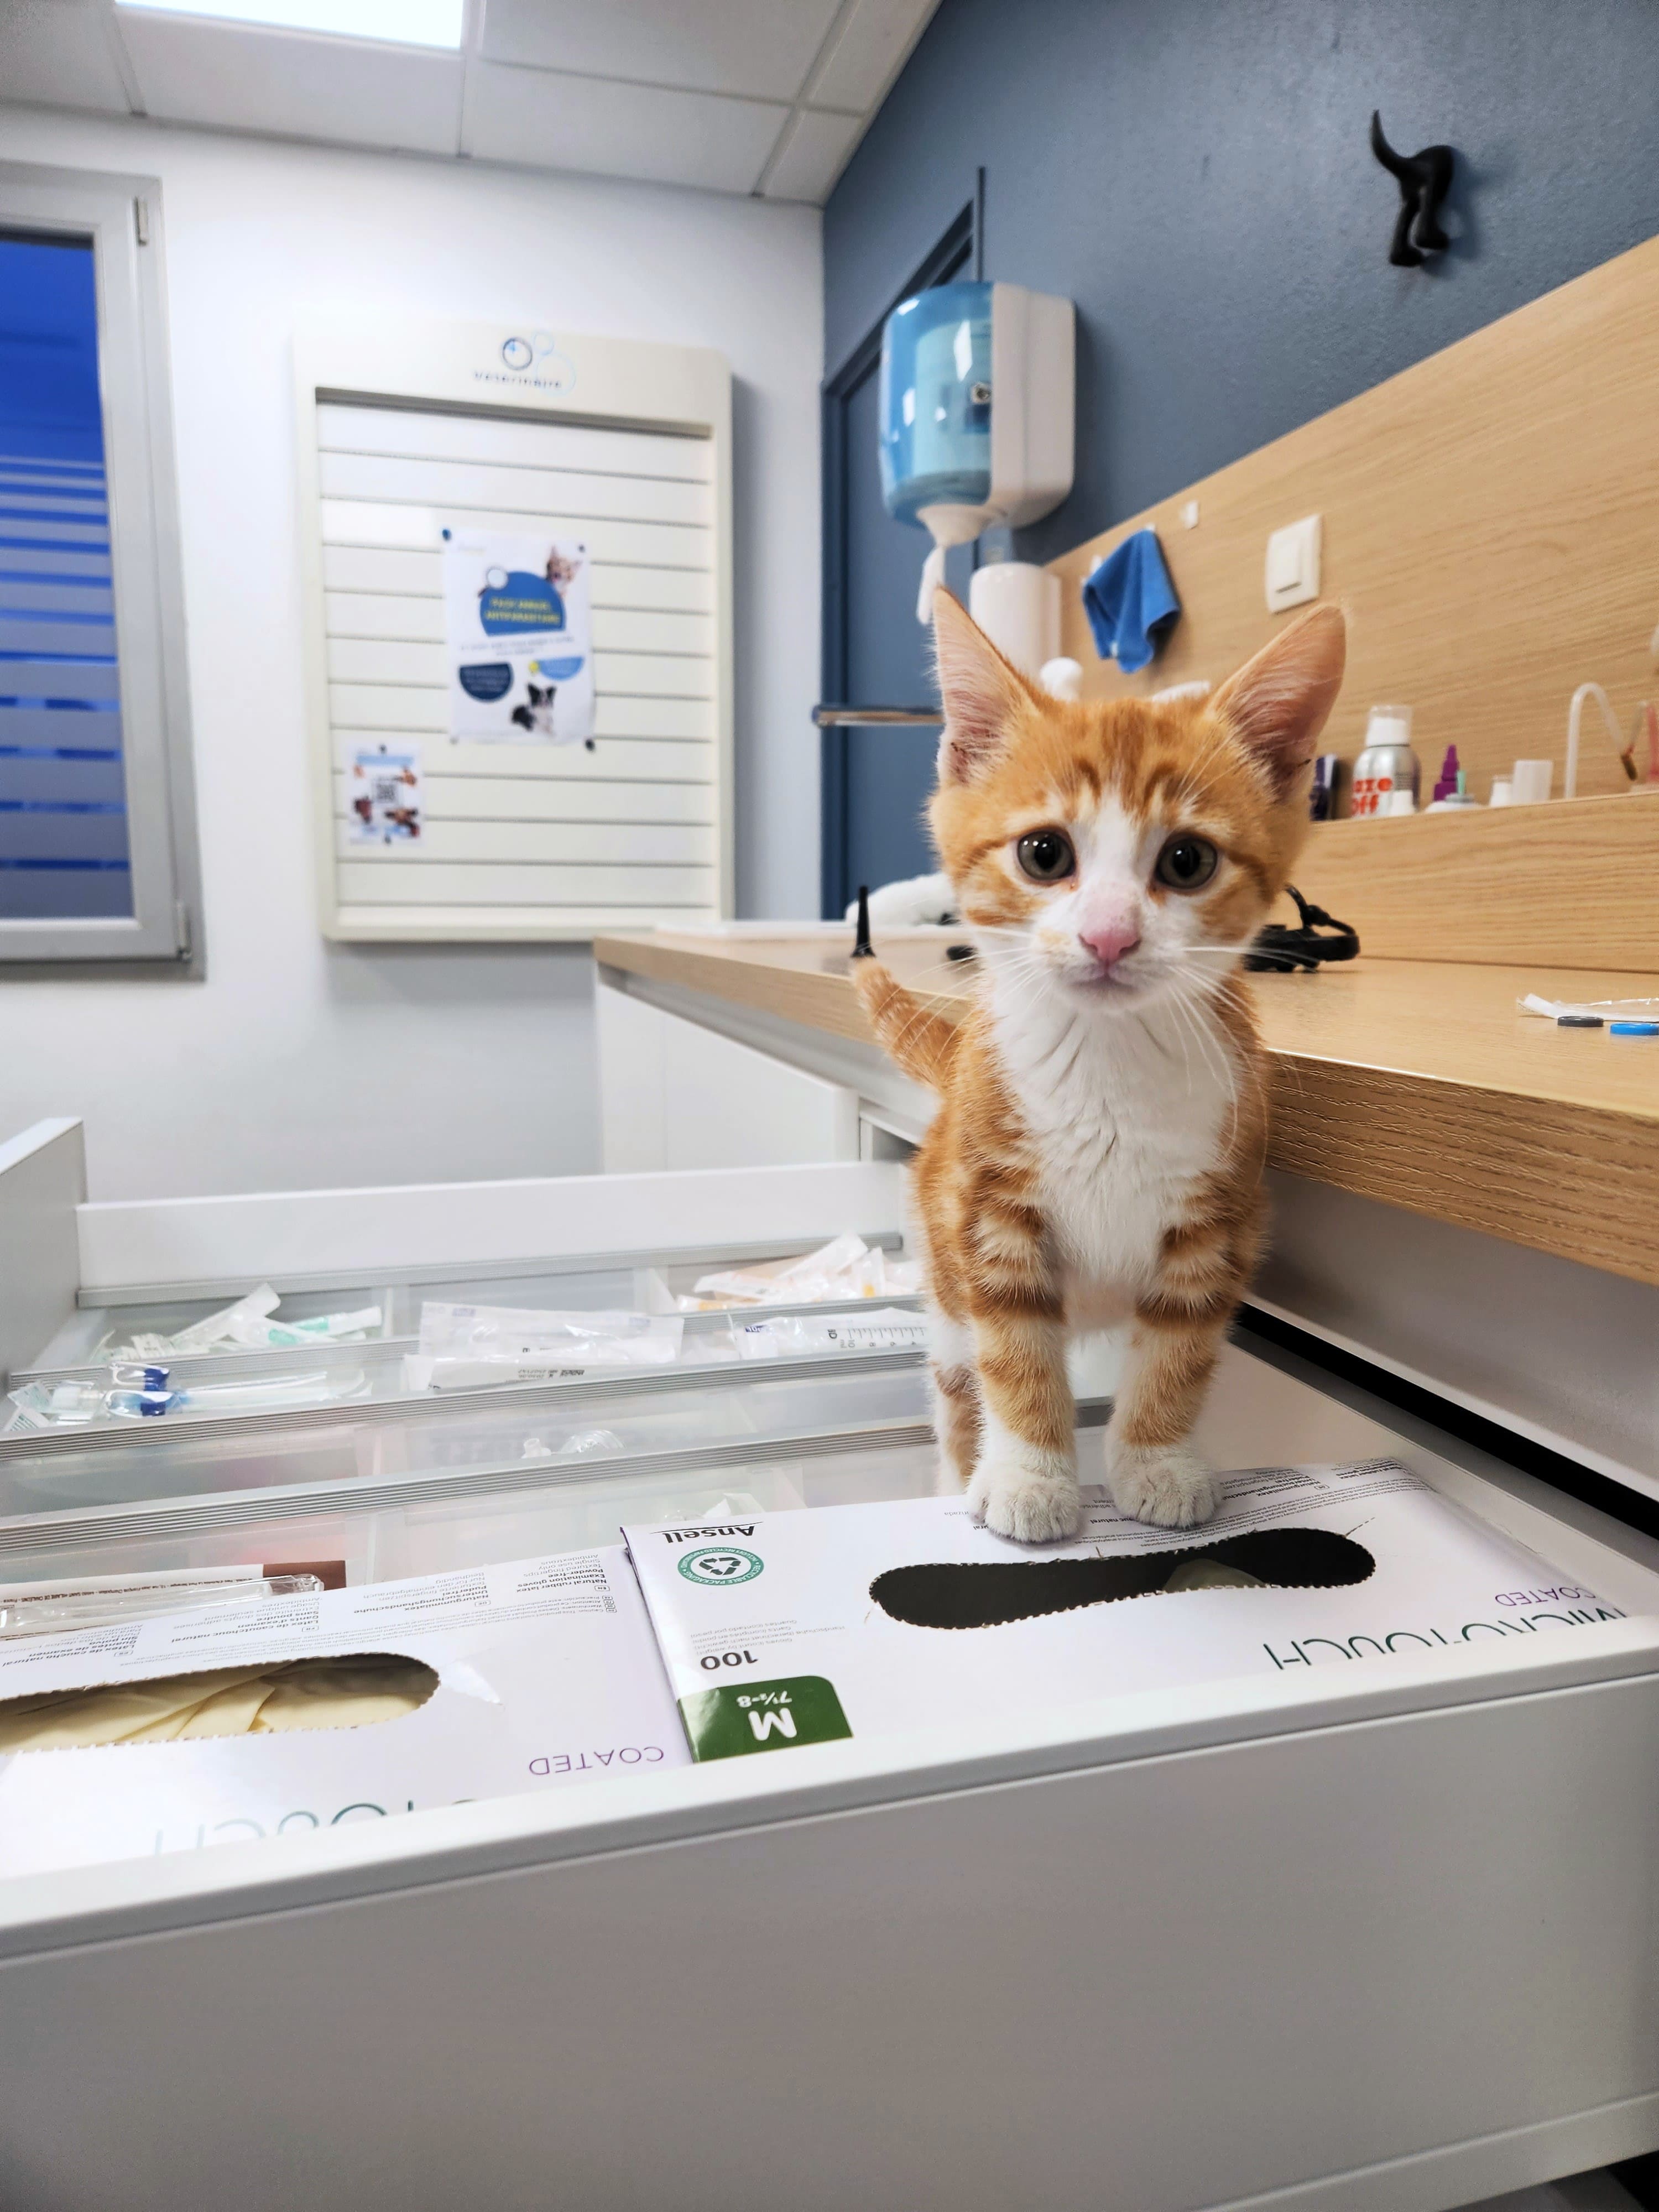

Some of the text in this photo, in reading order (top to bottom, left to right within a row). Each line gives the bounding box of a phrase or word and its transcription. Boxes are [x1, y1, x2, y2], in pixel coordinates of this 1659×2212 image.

[1256, 1481, 1321, 1496] Naturgummilatex
[661, 1526, 755, 1543] Ansell
[541, 1554, 598, 1566] Ambidextrous
[523, 1563, 601, 1577] Textured fingertips
[548, 1568, 603, 1578] Powder-free
[518, 1573, 605, 1588] Examination gloves
[442, 1585, 487, 1596] Puderfrei
[1494, 1585, 1597, 1608] COATED
[354, 1589, 488, 1614] Untersuchungshandschuhe
[404, 1594, 489, 1611] Naturgummilatex
[212, 1625, 273, 1636] caoutchouc
[2, 1657, 43, 1667] natural
[700, 1650, 759, 1670] 100
[748, 1707, 797, 1741] M
[529, 1746, 664, 1776] COATED
